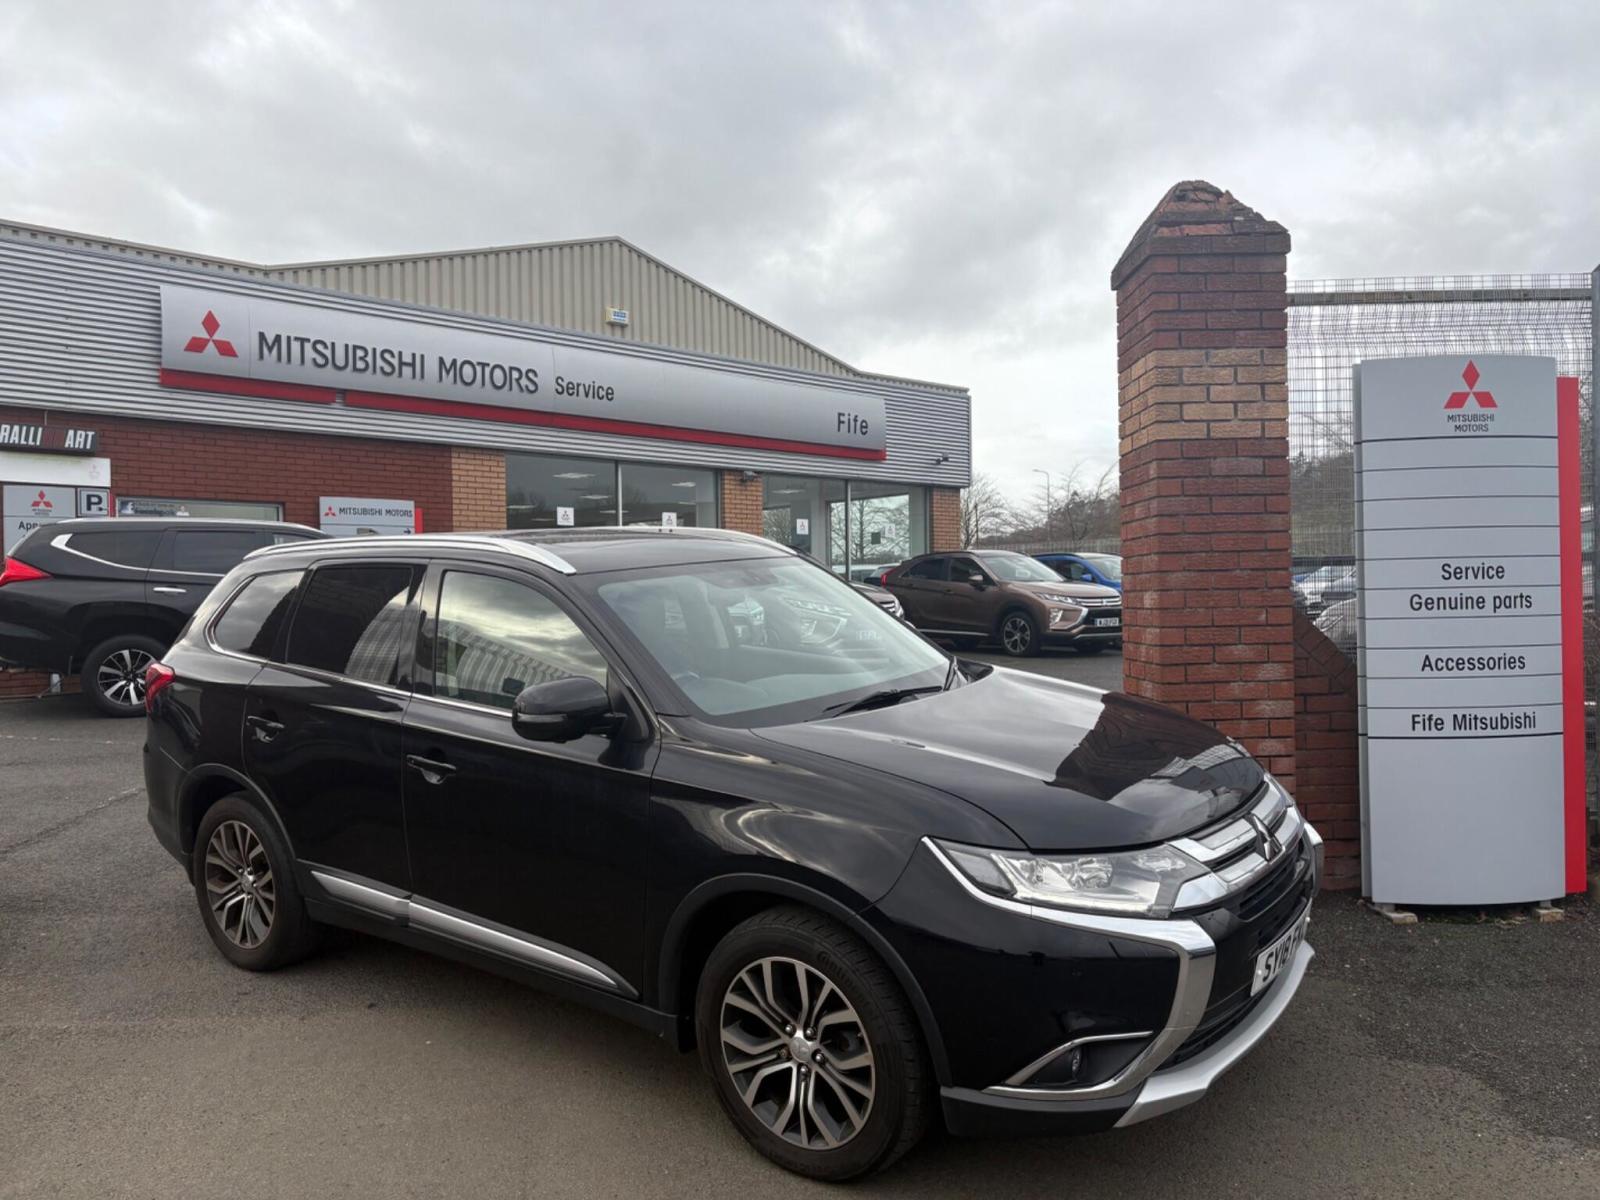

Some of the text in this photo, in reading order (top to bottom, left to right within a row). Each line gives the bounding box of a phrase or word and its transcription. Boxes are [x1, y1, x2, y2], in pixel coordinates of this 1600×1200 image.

[257, 331, 615, 402] MITSUBISHI MOTORS Service
[837, 412, 869, 436] Fife
[1447, 413, 1495, 423] MITSUBISHI
[1454, 424, 1489, 433] MOTORS
[0, 424, 95, 450] RALLI ART
[339, 507, 413, 518] MITSUBISHI MOTORS
[1441, 562, 1505, 580] Service
[1409, 592, 1533, 614] Genuine parts
[1421, 652, 1526, 673] Accessories
[1411, 711, 1536, 732] Fife Mitsubishi
